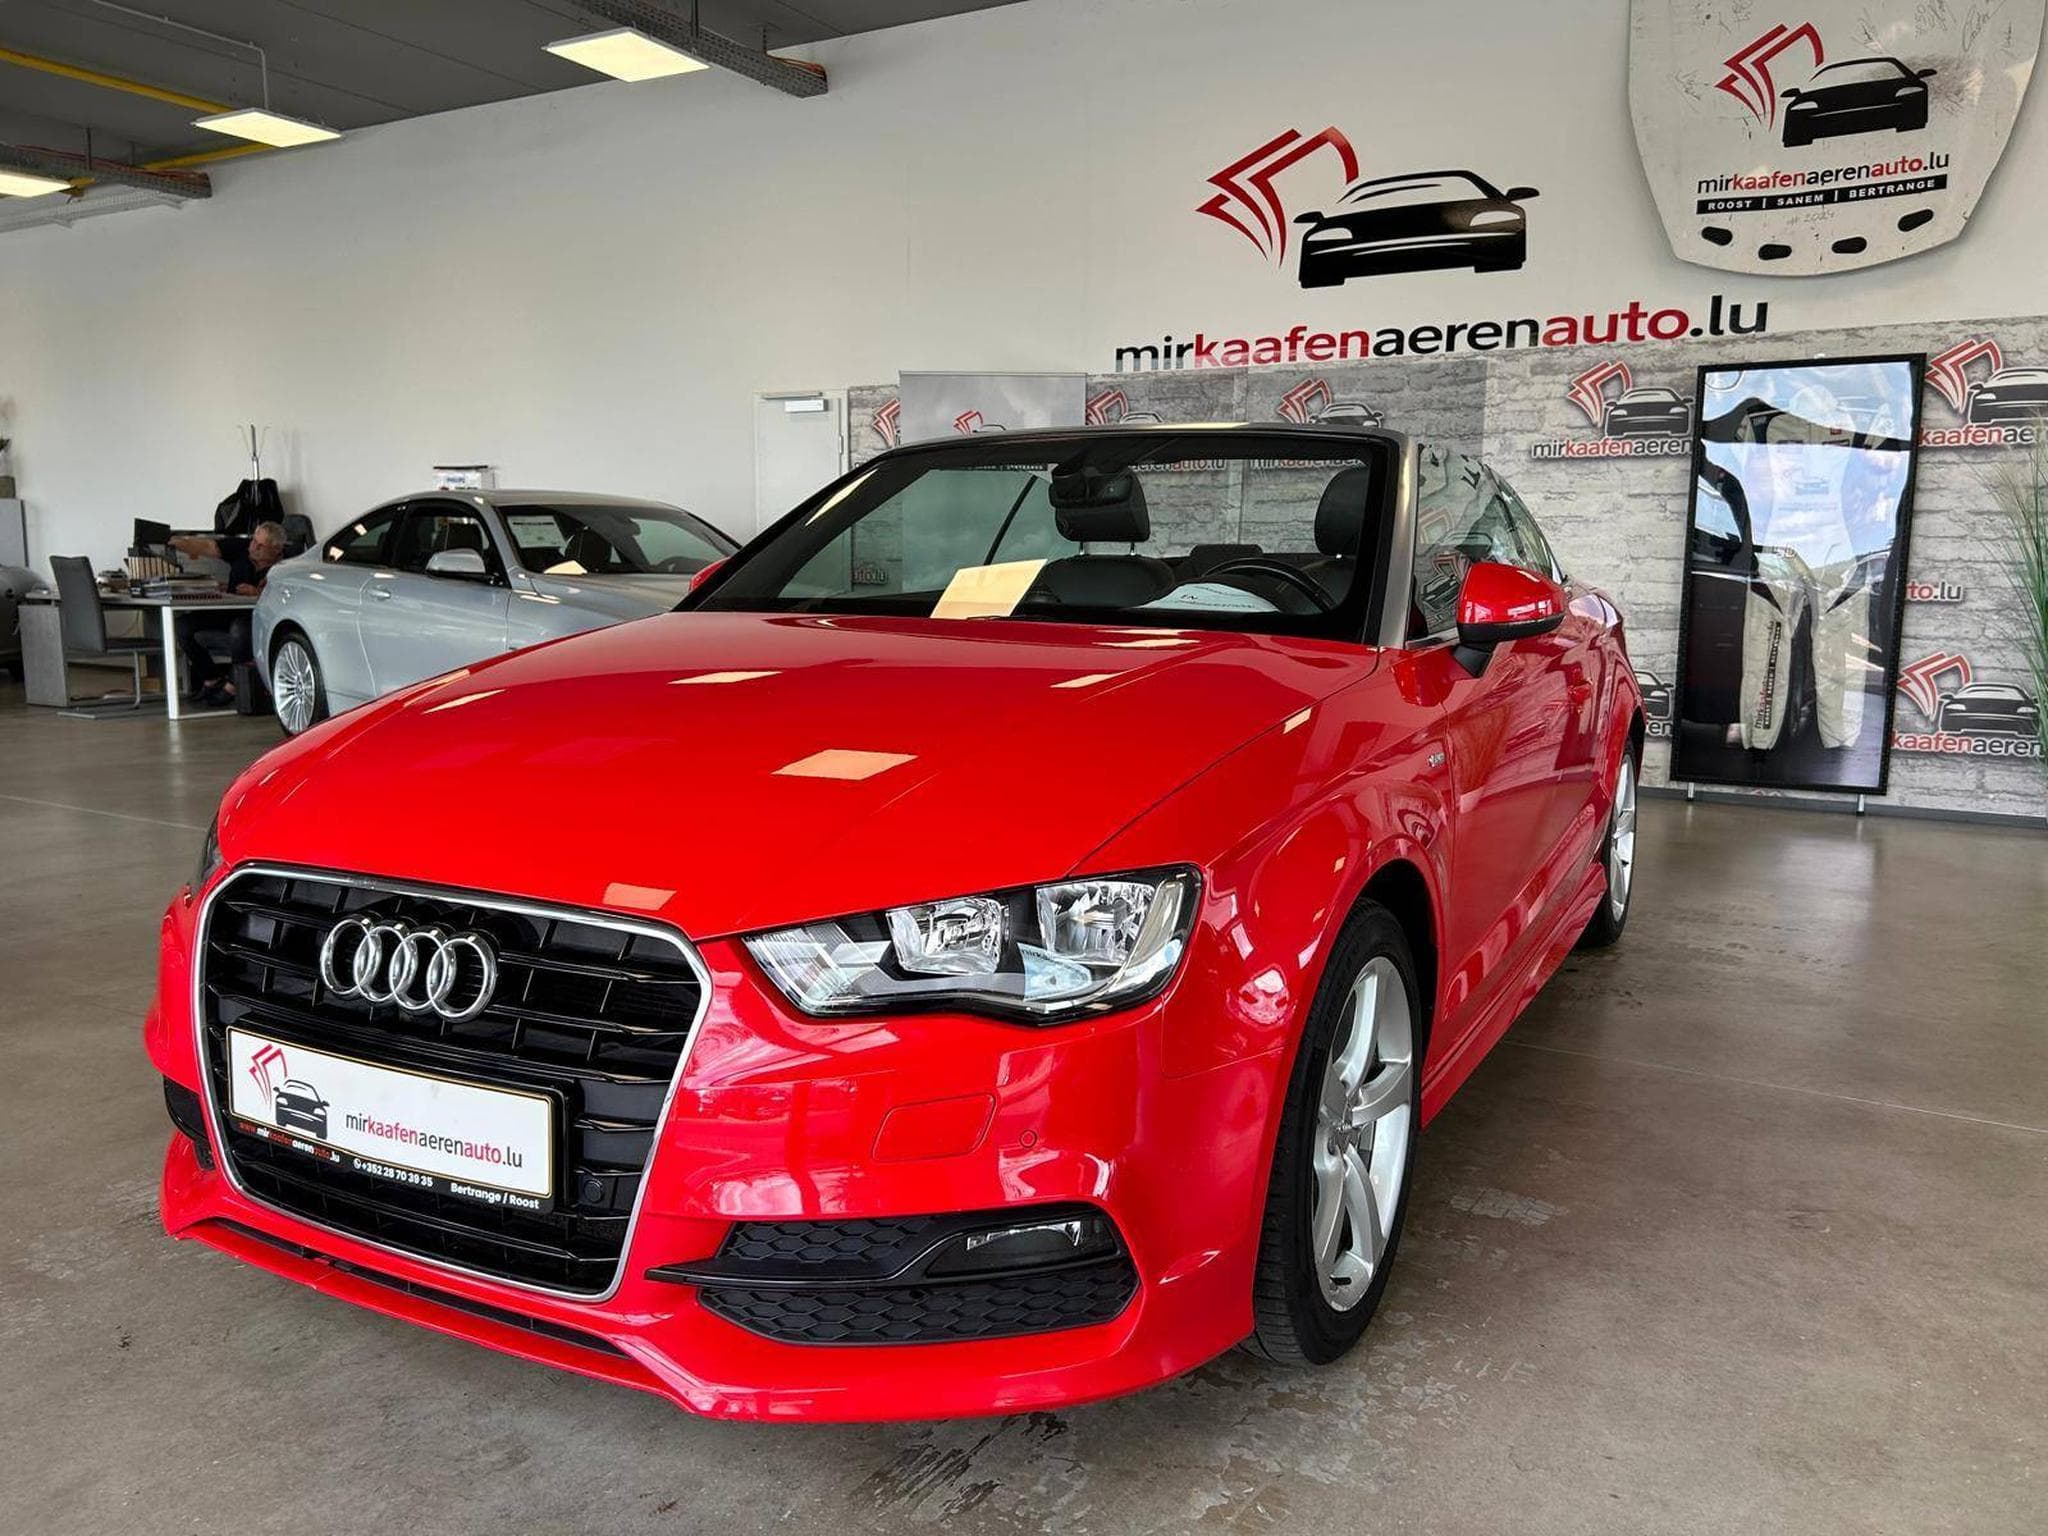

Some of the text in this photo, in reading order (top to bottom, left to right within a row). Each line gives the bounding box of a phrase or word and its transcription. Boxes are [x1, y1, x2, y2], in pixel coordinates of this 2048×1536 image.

[1697, 151, 1950, 194] mirkaafenaerenauto.lu
[1707, 199, 1752, 210] ROOST
[1776, 194, 1824, 207] SANEM
[1849, 179, 1936, 199] BERTRANGE
[1115, 295, 1769, 372] mirkaafenaerenauto.lu
[346, 1111, 523, 1169] mirkaafenaerenauto.lu
[383, 1166, 395, 1179] 28
[396, 1169, 408, 1182] 70
[420, 1174, 434, 1188] 35
[450, 1181, 501, 1204] Bertrange
[509, 1194, 540, 1211] Roost
